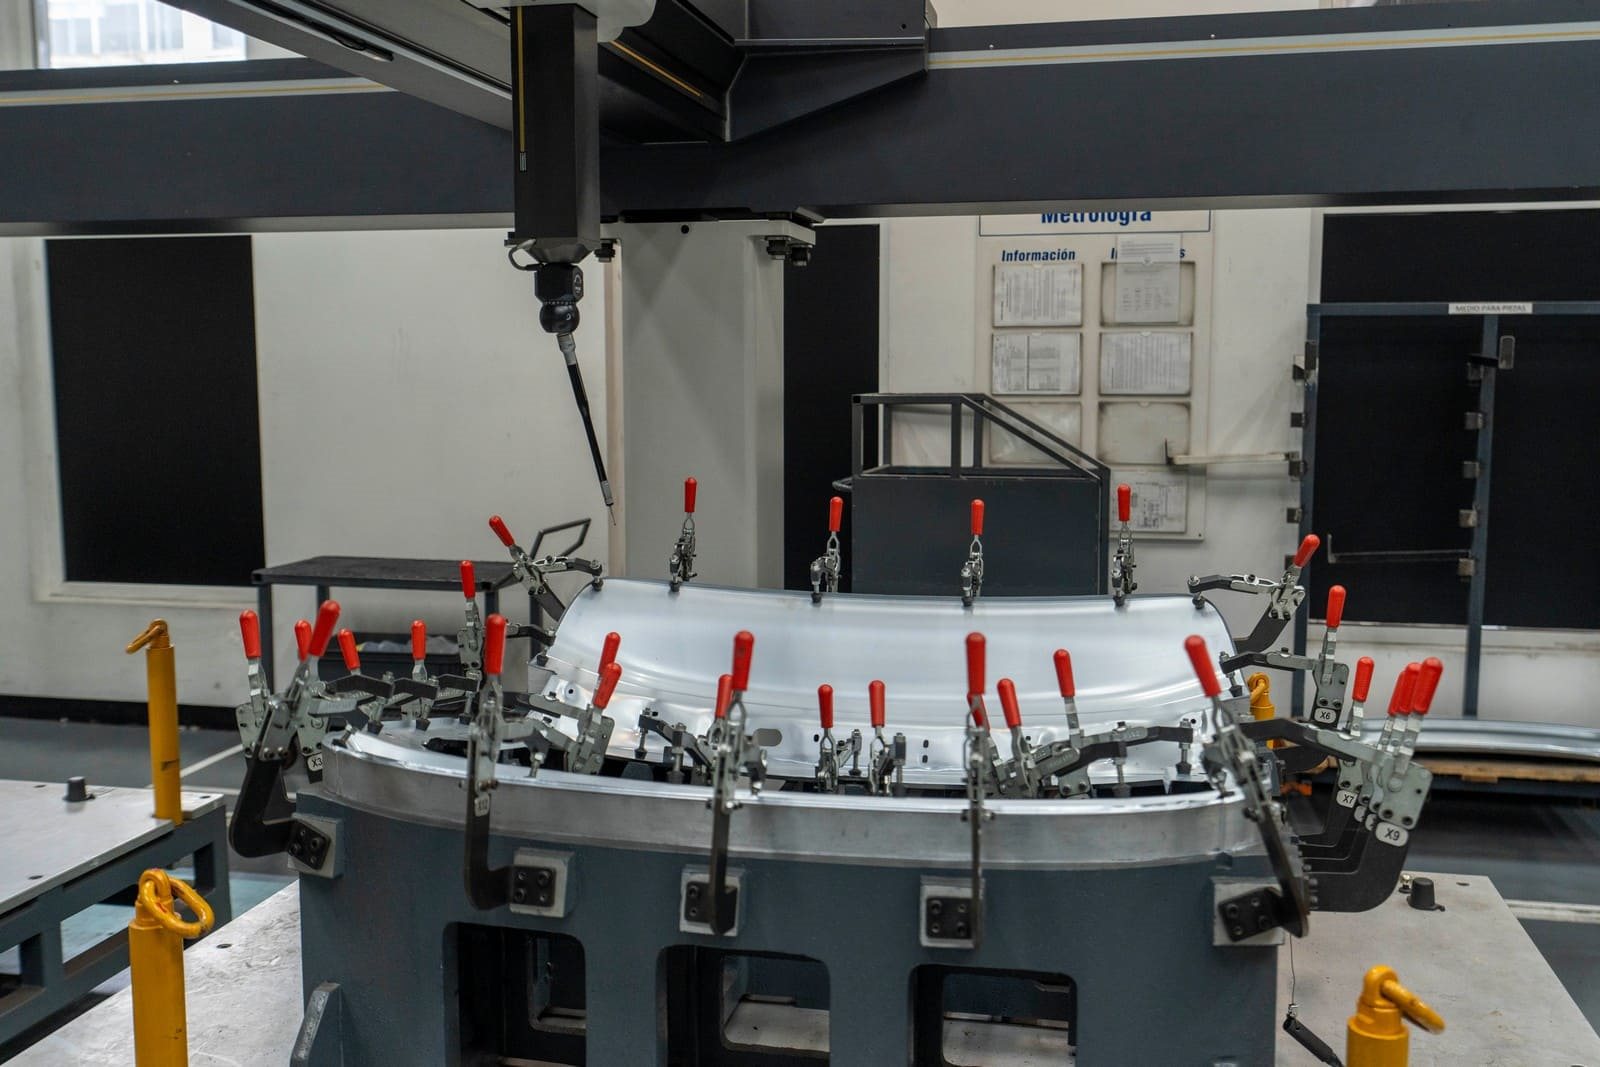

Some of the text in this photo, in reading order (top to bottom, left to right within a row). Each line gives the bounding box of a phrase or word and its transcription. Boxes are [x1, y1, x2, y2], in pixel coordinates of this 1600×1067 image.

[1001, 248, 1076, 262] Información
[1455, 304, 1527, 313] MEDIO PARA PIEZAS
[1319, 711, 1331, 720] X6
[311, 757, 323, 768] X3
[1343, 793, 1355, 805] X7
[1384, 827, 1401, 842] X9
